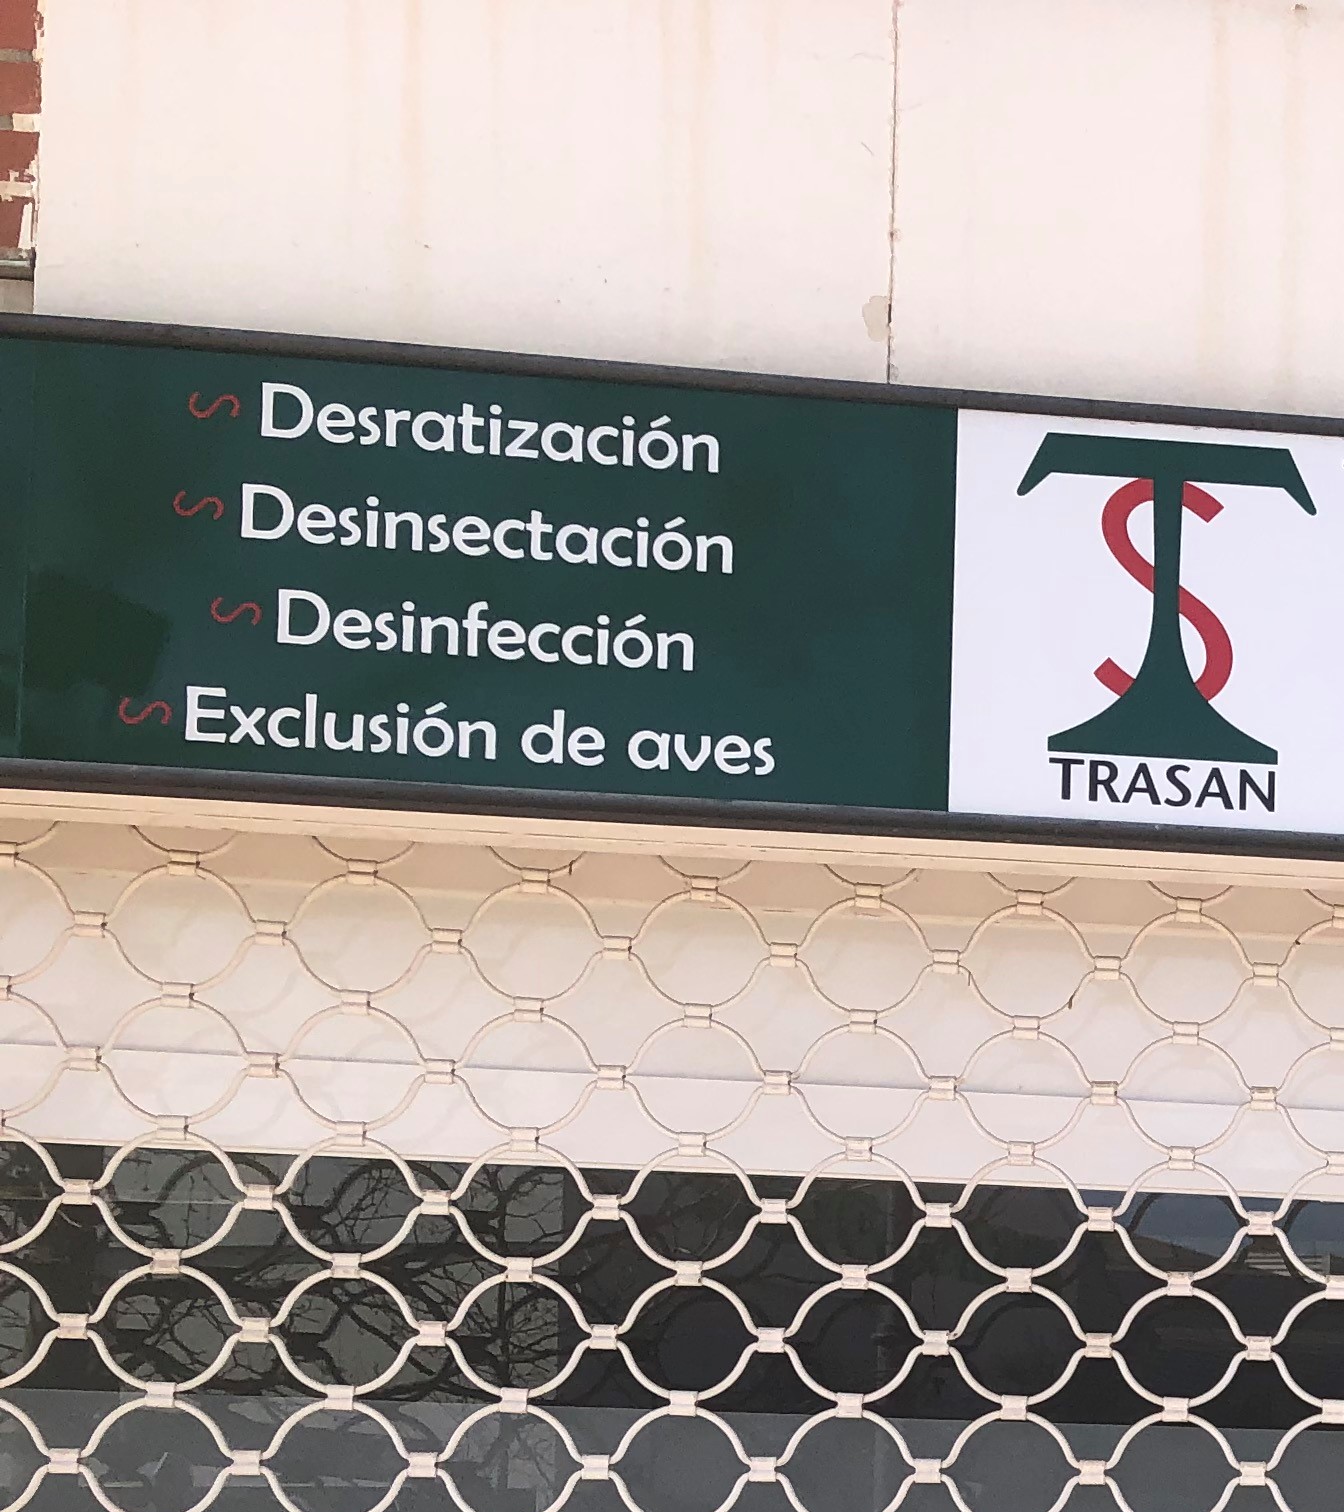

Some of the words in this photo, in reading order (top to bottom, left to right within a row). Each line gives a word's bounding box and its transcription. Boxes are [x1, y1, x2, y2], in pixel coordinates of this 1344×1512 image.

[261, 382, 719, 472] Desratización
[241, 483, 732, 573] Desinsectación
[277, 589, 693, 670] Desinfección
[185, 686, 496, 759] Exclusión
[522, 710, 605, 766] de
[628, 731, 774, 775] aves
[1049, 758, 1275, 812] TRASAN
